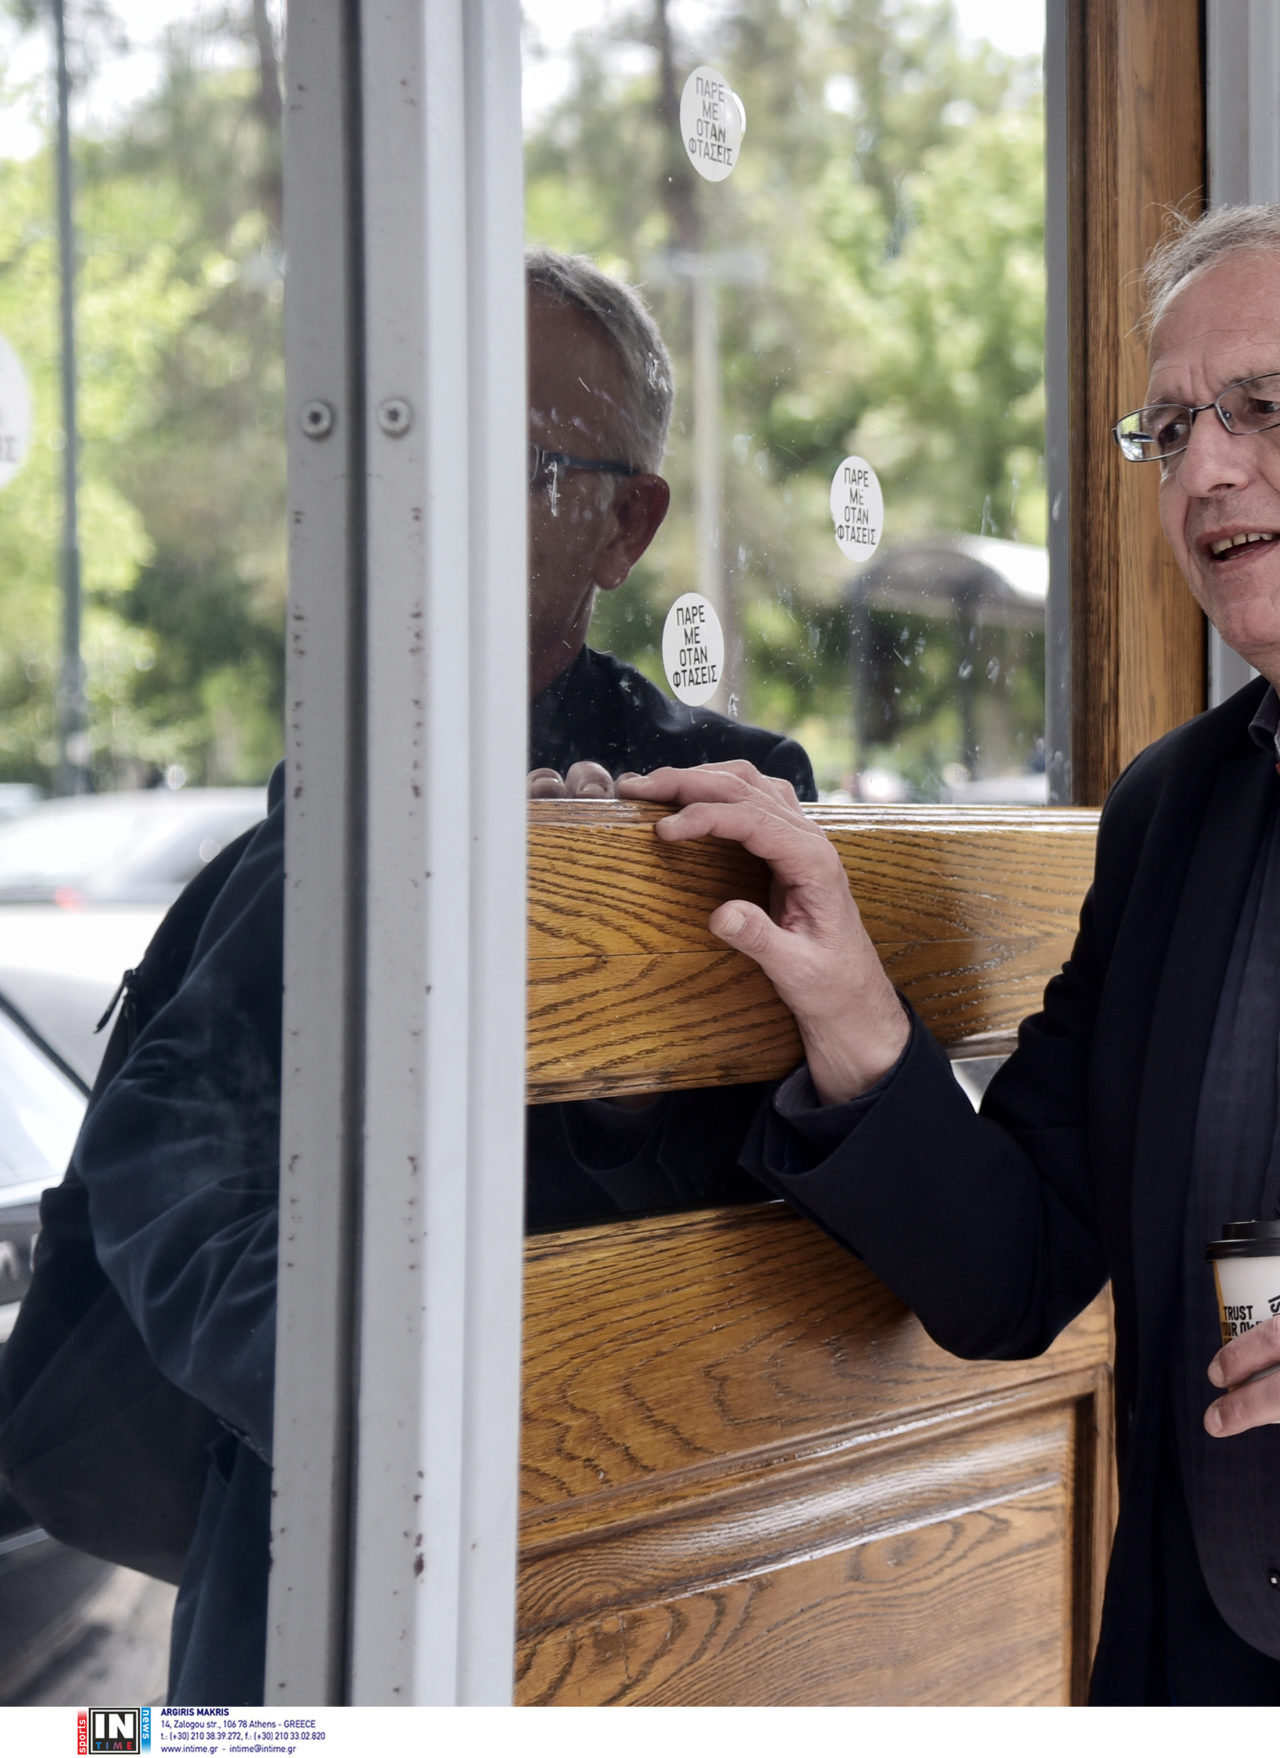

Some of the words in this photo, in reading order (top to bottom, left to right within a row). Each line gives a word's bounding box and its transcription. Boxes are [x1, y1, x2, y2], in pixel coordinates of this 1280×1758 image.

[695, 76, 725, 102] ΠΑΡΕ
[702, 99, 719, 121] ΜΕ
[696, 118, 726, 143] ΟΤΑΝ
[688, 137, 733, 167] ΦΤΑΣΕΙΣ
[844, 467, 869, 488] ΠΑΡΕ
[849, 487, 864, 506] ΜΕ
[844, 505, 869, 525] ΟΤΑΝ
[837, 524, 876, 546] ΦΤΑΣΕΙΣ
[676, 605, 706, 626] ΠΑΡΕ
[684, 626, 701, 646] ΜΕ
[680, 645, 708, 667] ΟΤΑΝ
[672, 664, 718, 688] ΦΤΑΣΕΙΣ
[1223, 1305, 1254, 1321] TRUST
